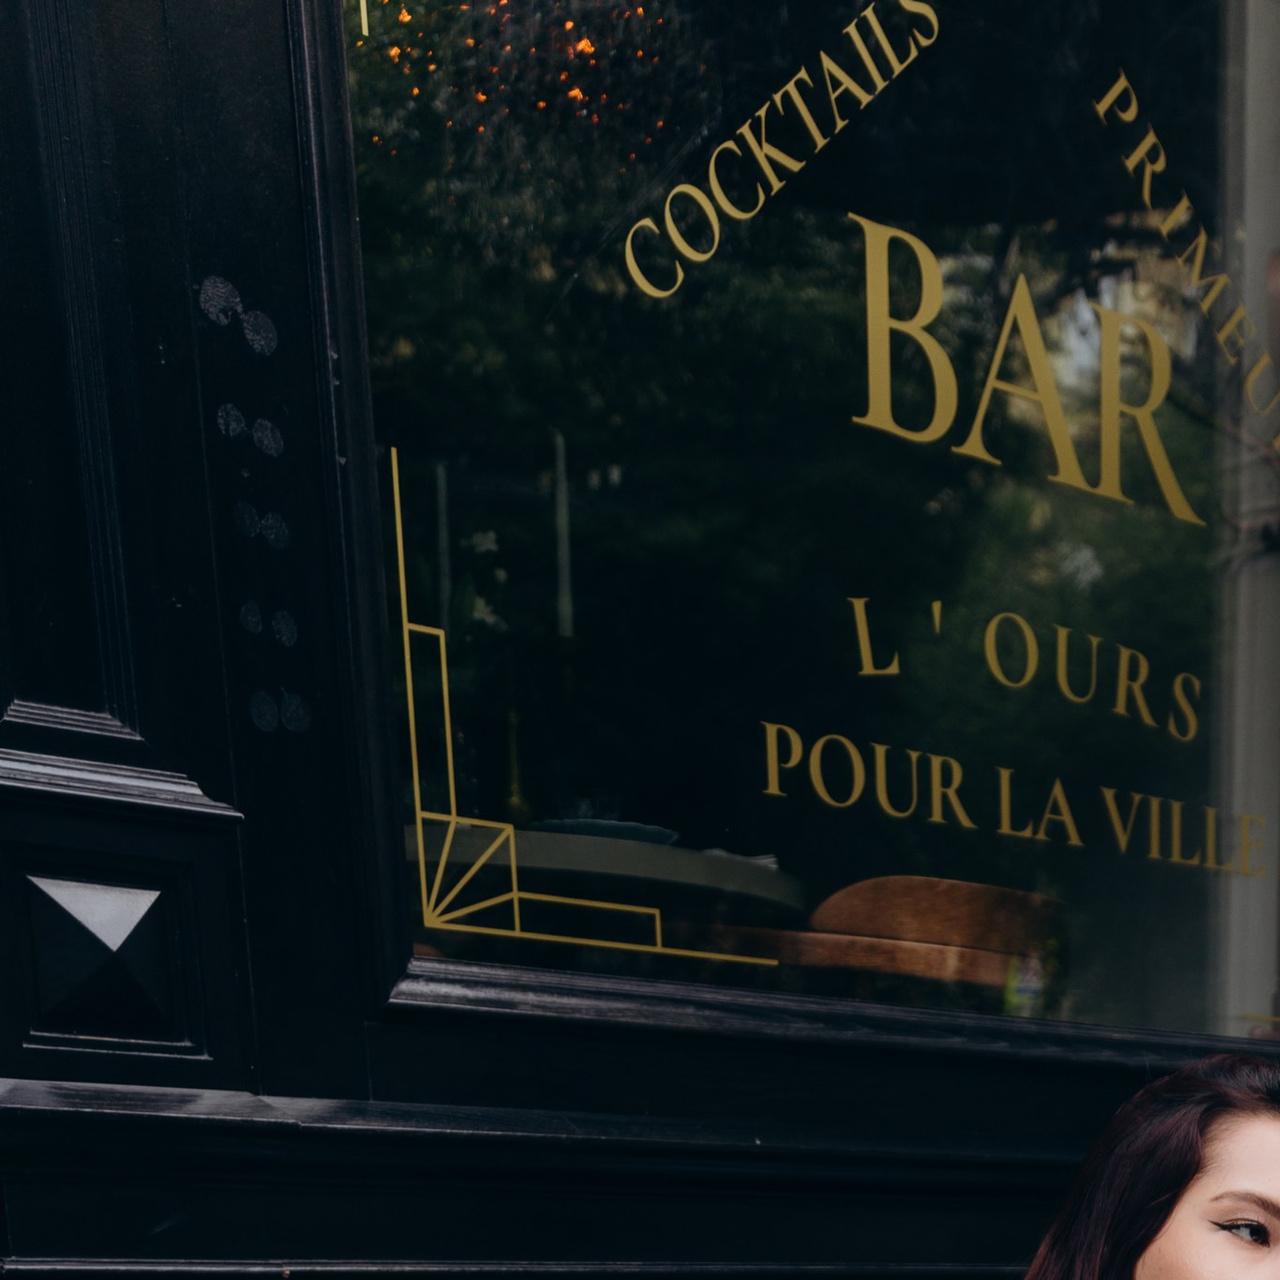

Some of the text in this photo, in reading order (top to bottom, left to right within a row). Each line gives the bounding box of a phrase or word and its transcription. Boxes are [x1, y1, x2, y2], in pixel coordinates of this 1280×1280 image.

[625, 0, 939, 298] COCKTAILS
[848, 212, 1206, 526] BAR
[761, 721, 1266, 877] POUR LA VILLE
